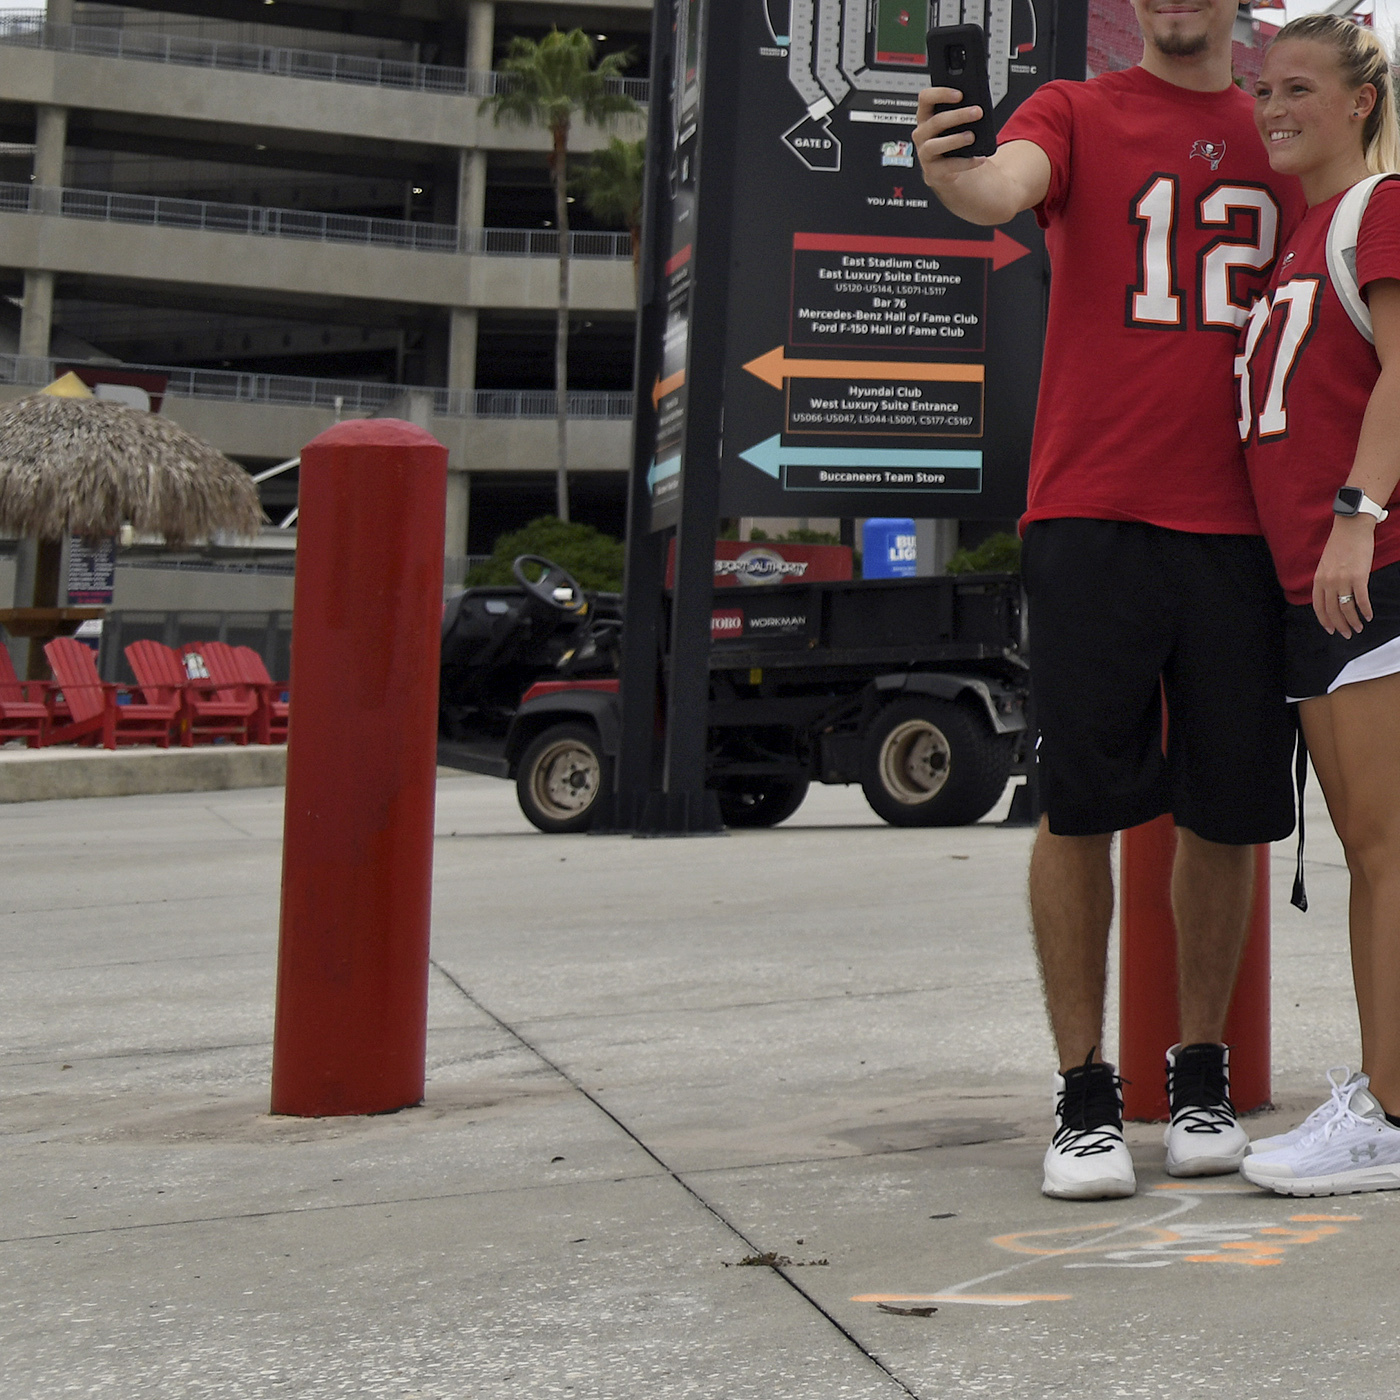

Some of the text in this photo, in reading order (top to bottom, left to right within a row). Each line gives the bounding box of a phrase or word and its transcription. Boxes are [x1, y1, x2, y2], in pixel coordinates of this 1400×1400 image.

[794, 138, 831, 149] GATE D
[868, 198, 885, 206] YOU
[887, 198, 904, 206] ARE
[1126, 173, 1280, 331] 12
[843, 256, 940, 270] East Stadium Club
[819, 268, 961, 284] East Luxury Suite Entrance
[874, 298, 906, 308] Bar 76
[799, 309, 978, 325] Mercedes-Benz Hall of Fame Club
[812, 322, 964, 337] Ford F-150 Hall of Fame Club
[850, 386, 921, 398] Hyundai Club
[810, 398, 959, 412] West Luxury Suite Entrance
[819, 471, 945, 483] Buccaneers Team Store
[896, 535, 917, 548] BU
[890, 547, 917, 561] LIG
[750, 616, 806, 628] WORKMAN
